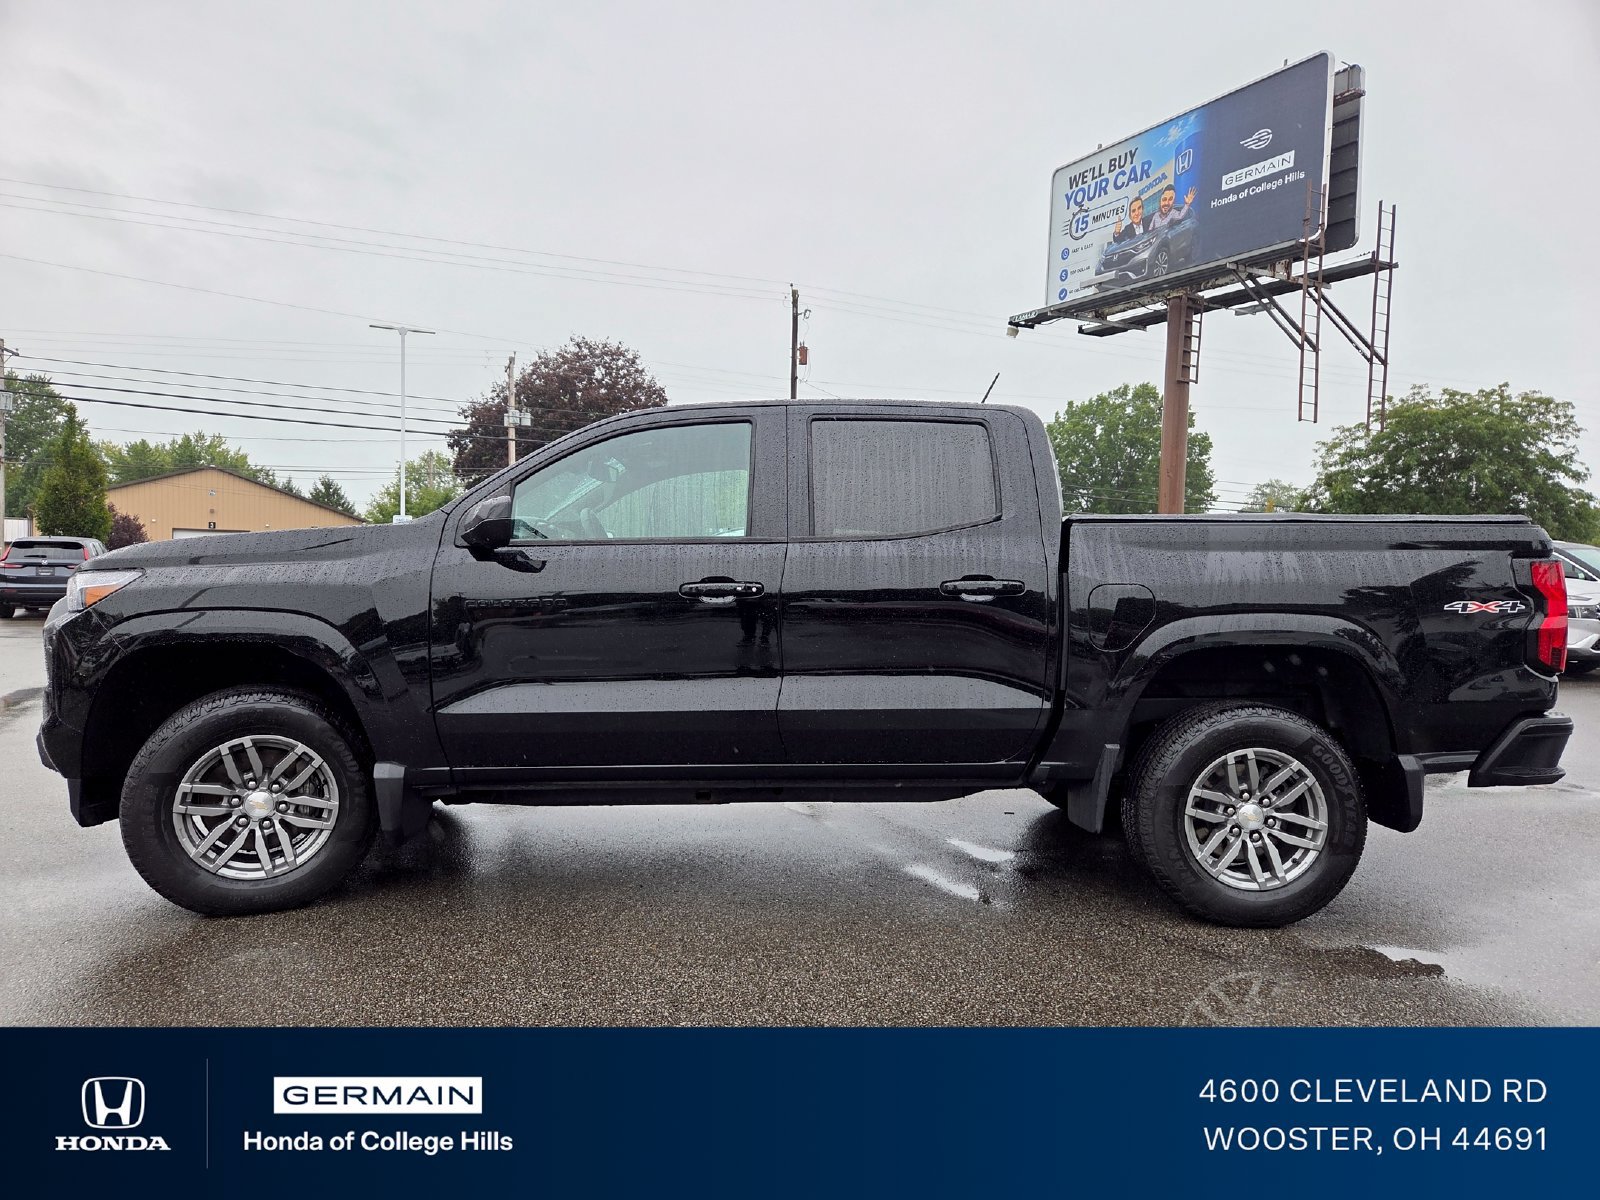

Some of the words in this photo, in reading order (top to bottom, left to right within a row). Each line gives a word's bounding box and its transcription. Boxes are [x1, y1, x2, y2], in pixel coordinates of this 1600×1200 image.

[1064, 177, 1109, 210] YOUR
[1113, 159, 1152, 190] CAR
[1068, 164, 1105, 190] WE'LL
[1108, 147, 1139, 173] BUY
[1225, 155, 1291, 186] GERMAIN
[1210, 194, 1238, 208] Honda
[1239, 188, 1249, 199] of
[1249, 178, 1283, 195] College
[1284, 170, 1306, 184] Hills
[1074, 213, 1090, 233] 15
[1092, 205, 1126, 225] MINUTES
